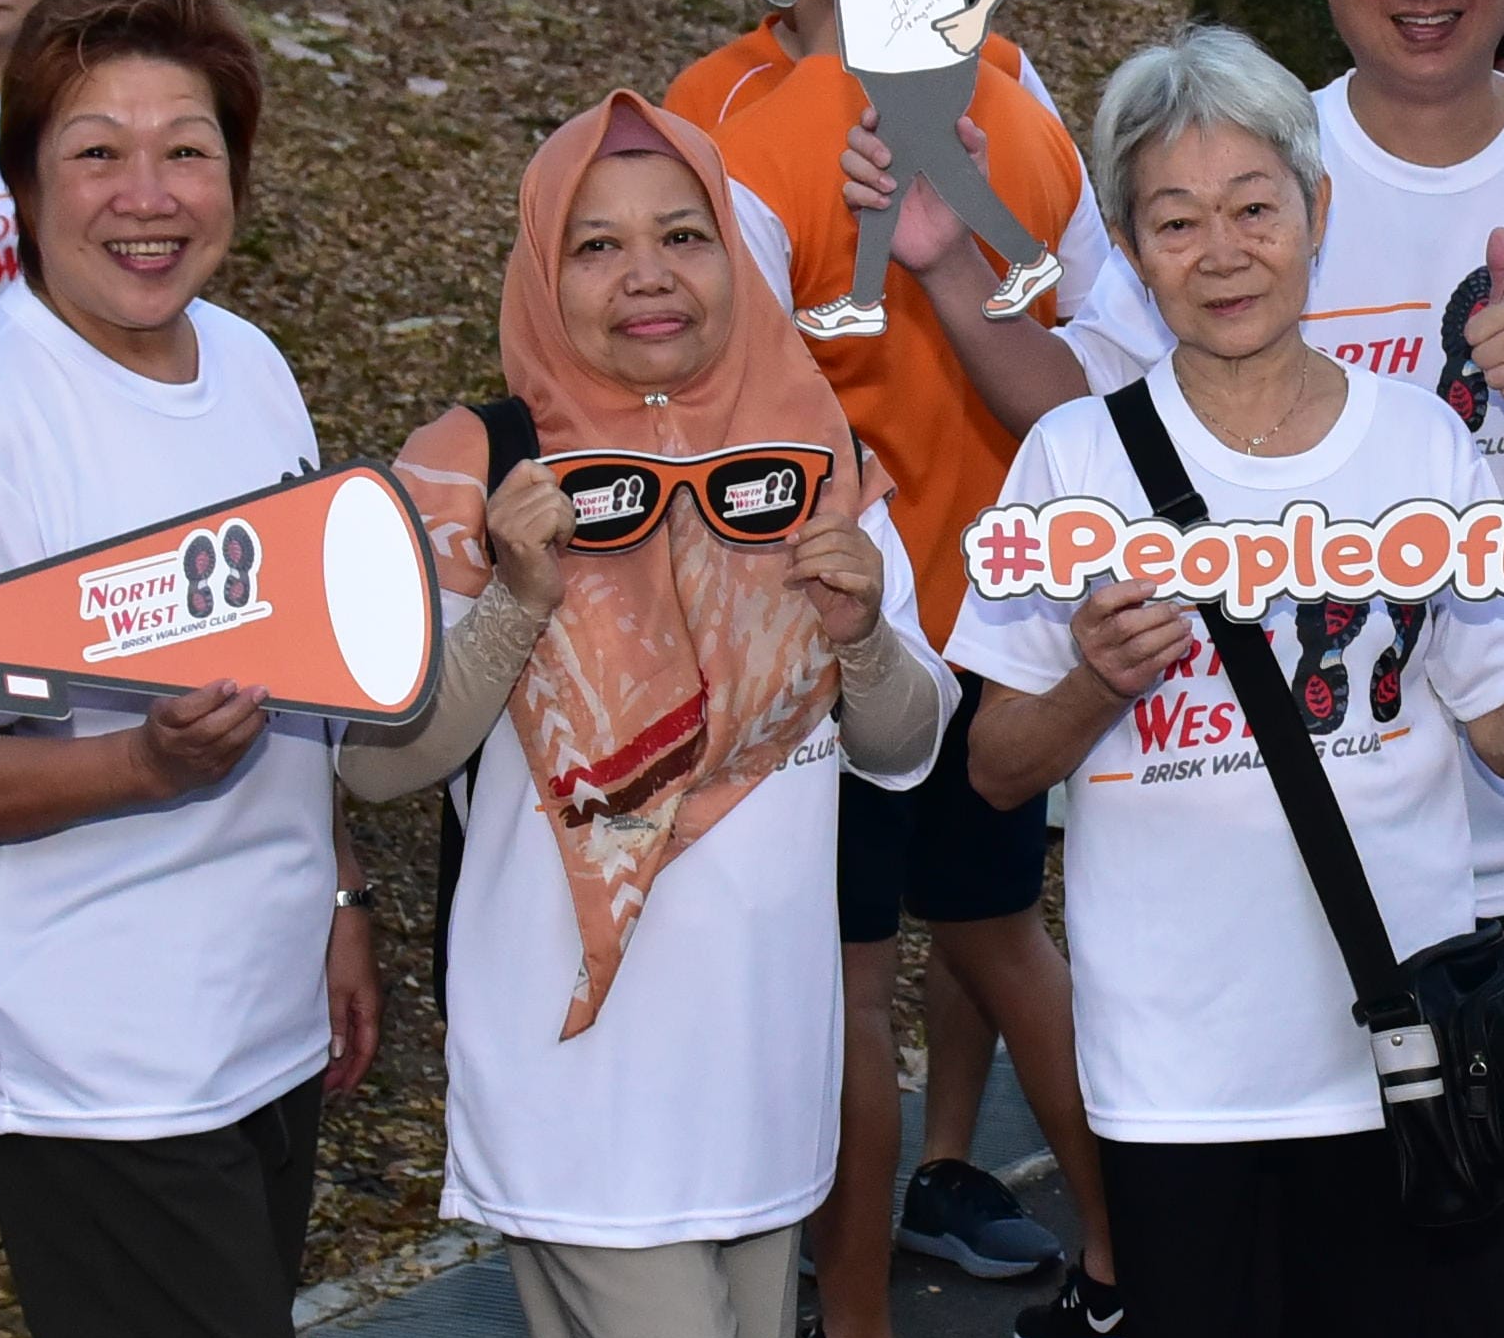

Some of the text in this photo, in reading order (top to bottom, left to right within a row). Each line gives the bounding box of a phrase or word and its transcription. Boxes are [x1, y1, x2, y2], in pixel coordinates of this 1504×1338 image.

[1316, 336, 1424, 374] RTH
[86, 573, 176, 614] NORTH
[111, 604, 179, 637] WEST
[121, 612, 237, 650] BRISK WALKING CLUB
[1141, 757, 1207, 785] BRISK
